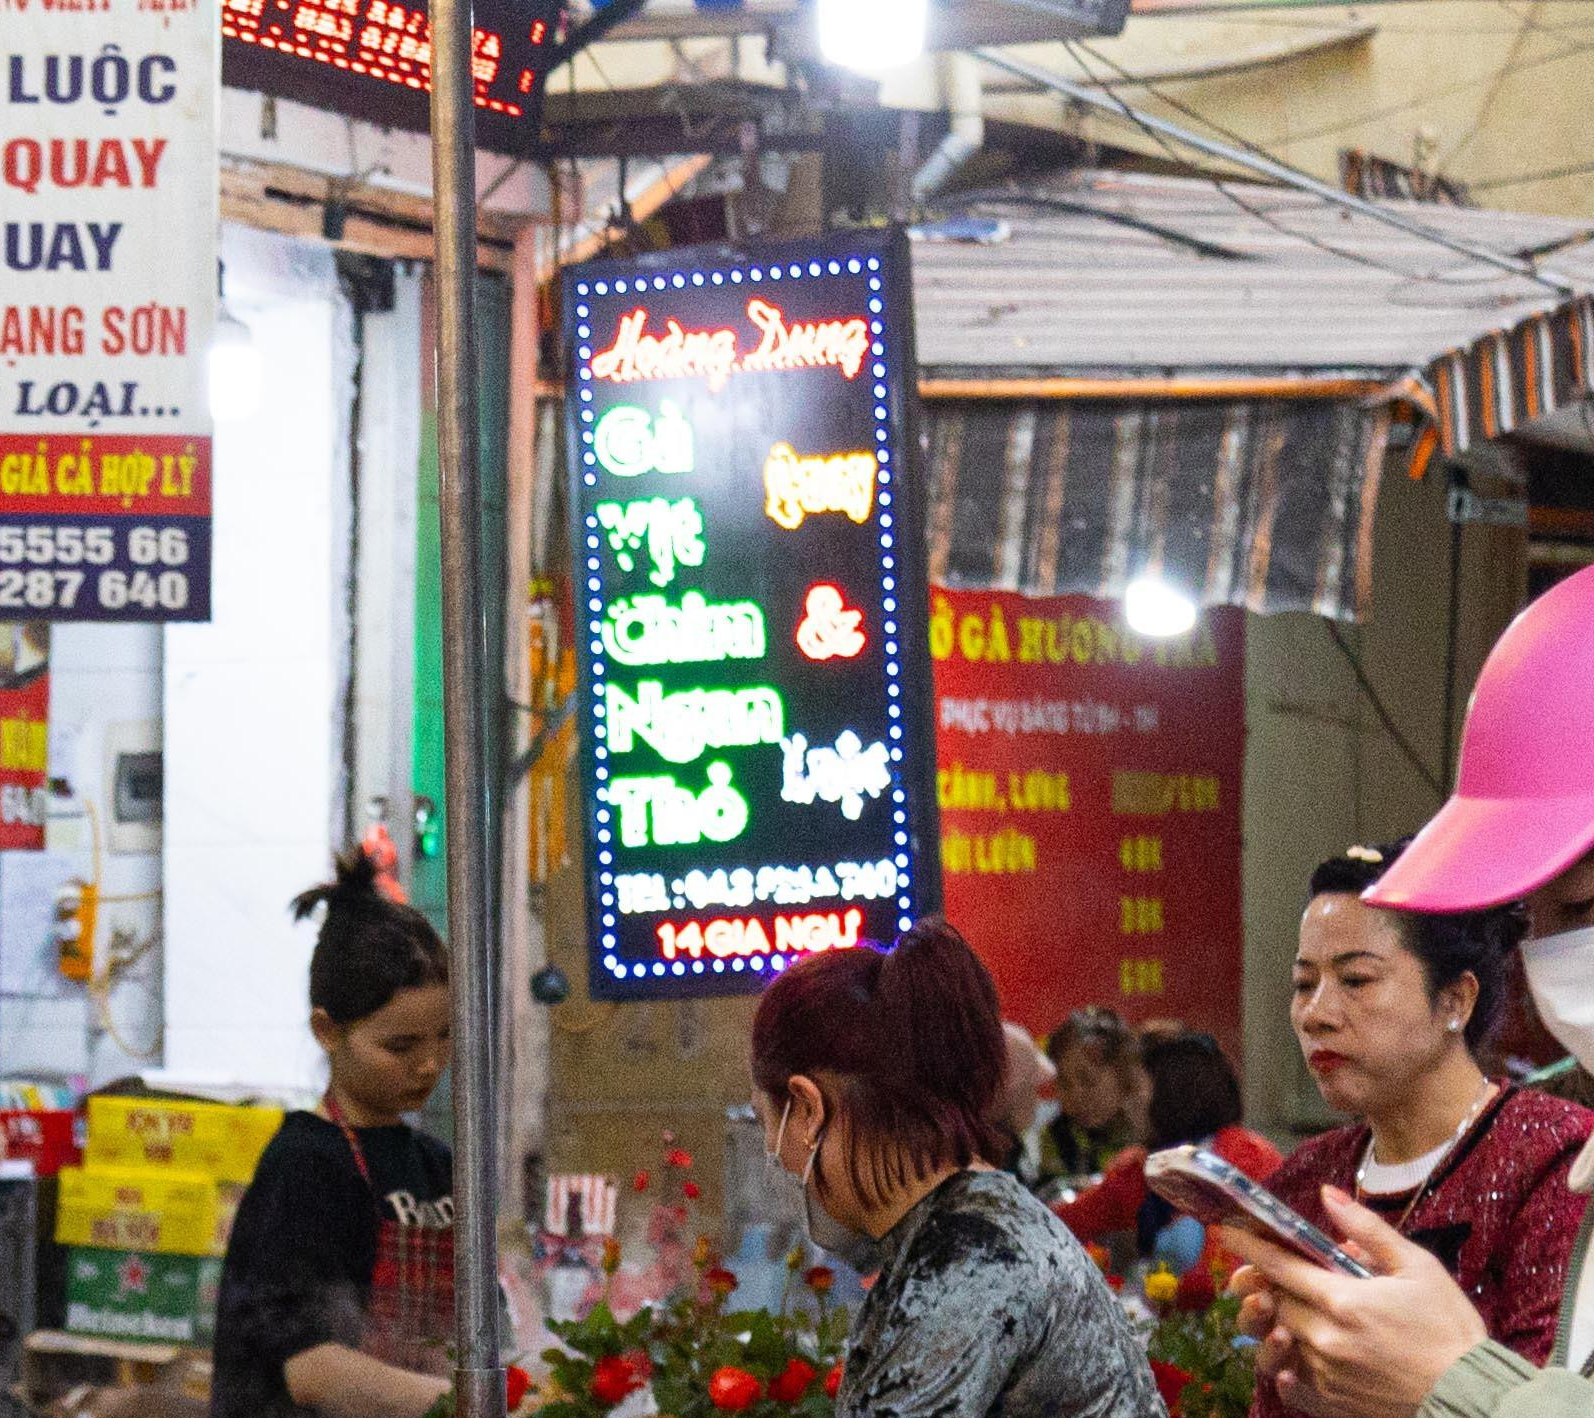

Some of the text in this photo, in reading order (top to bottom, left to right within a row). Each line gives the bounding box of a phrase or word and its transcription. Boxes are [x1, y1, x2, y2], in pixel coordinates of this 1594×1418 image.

[9, 43, 177, 117] LUỘC
[1, 138, 169, 193] QUAY
[101, 304, 188, 355] SƠN
[740, 296, 871, 379] Dung
[591, 400, 695, 477] Gà
[1, 443, 50, 495] GIÁ
[56, 437, 94, 495] CẢ
[99, 449, 155, 507] HỢP
[162, 438, 197, 495] LÝ
[128, 527, 189, 565] 66
[99, 571, 189, 609] 640
[795, 582, 869, 662] &
[656, 919, 705, 960] 14
